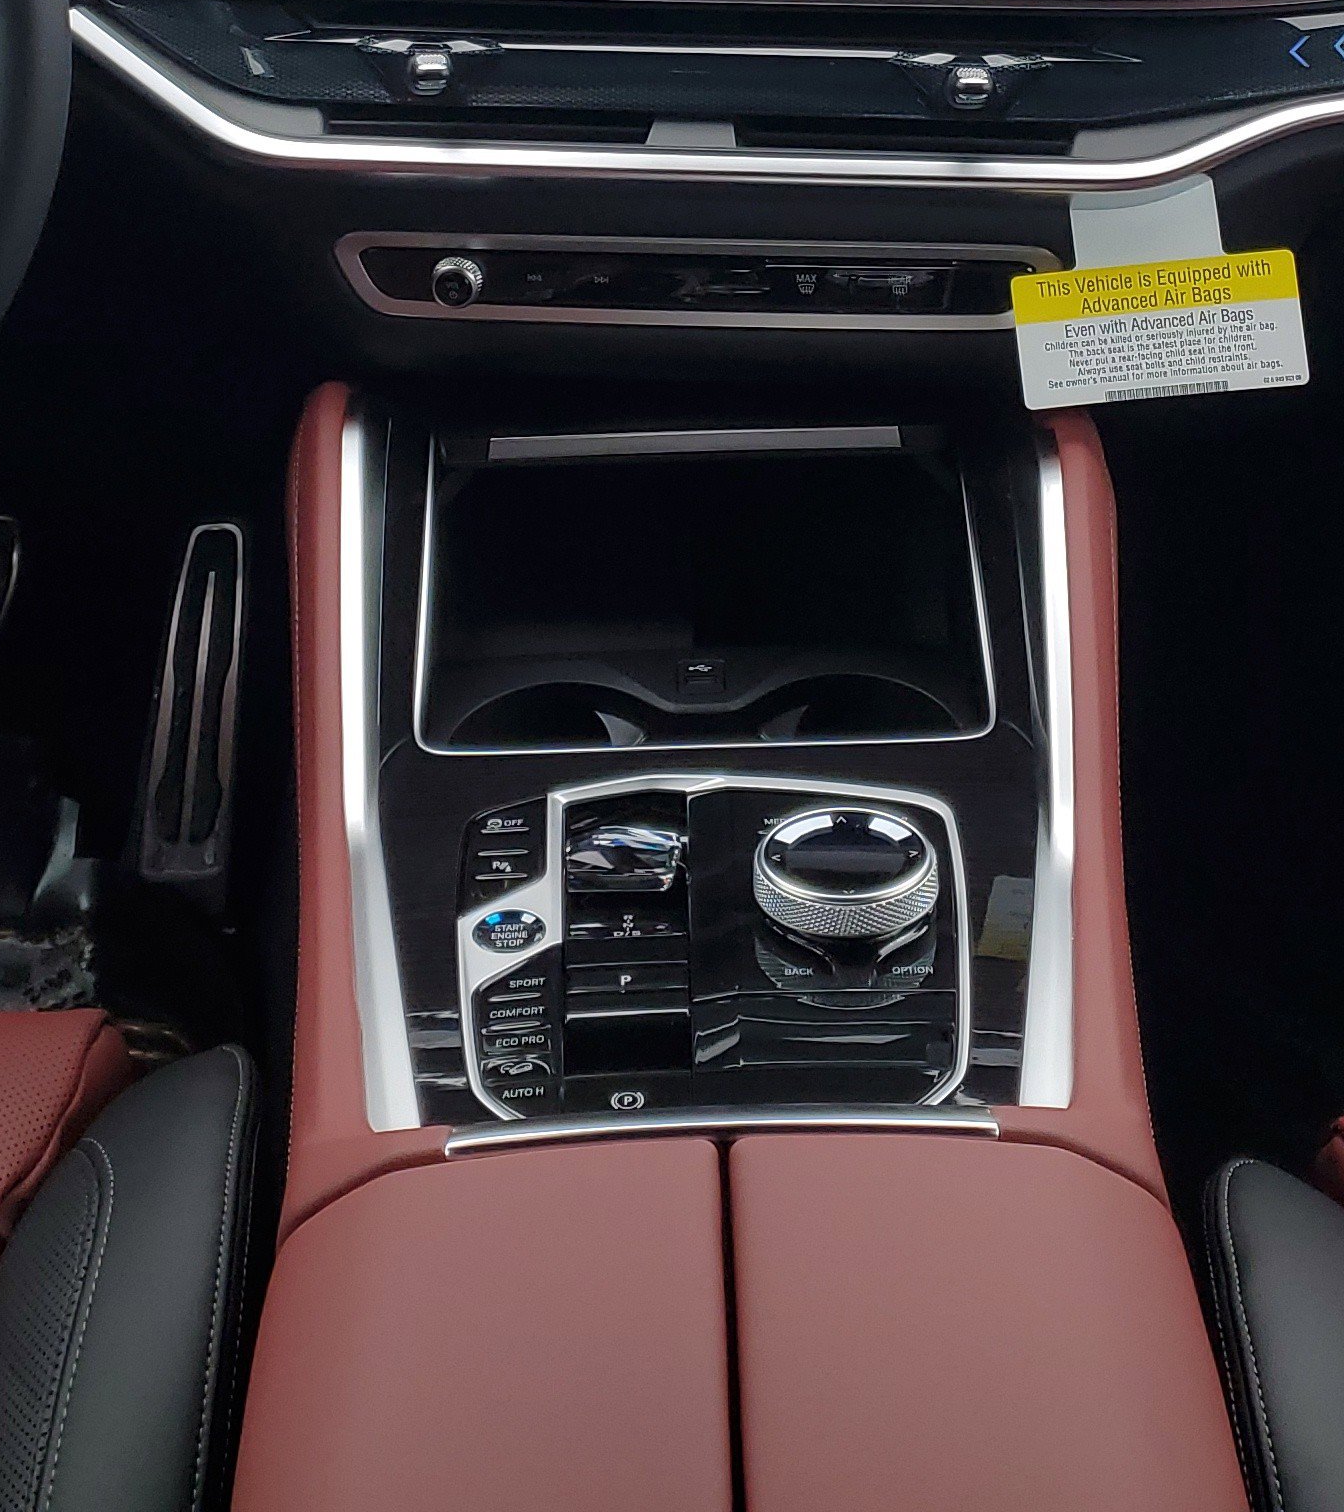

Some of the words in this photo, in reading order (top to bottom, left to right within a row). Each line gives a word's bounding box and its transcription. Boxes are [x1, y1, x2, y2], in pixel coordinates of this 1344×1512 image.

[796, 274, 817, 283] MAX
[1036, 279, 1071, 298] This
[1074, 273, 1133, 294] Vehicle
[1138, 271, 1152, 288] is
[1157, 262, 1231, 287] Equipped
[1236, 259, 1271, 278] with
[1081, 290, 1158, 314] Advanced
[1164, 289, 1187, 306] Air
[1192, 287, 1232, 304] Bags
[1064, 324, 1096, 339] Even
[1099, 319, 1128, 335] with
[1131, 312, 1195, 332] Advanced
[1199, 310, 1217, 325] Air
[1221, 308, 1254, 324] Bags
[1044, 341, 1079, 352] Children
[1081, 339, 1096, 348] can
[1098, 337, 1108, 346] be
[1110, 334, 1133, 345] killed
[1145, 330, 1184, 342] seriously
[1186, 327, 1215, 338] injured
[1218, 326, 1227, 336] by
[1230, 324, 1244, 333] the
[1246, 323, 1257, 331] air
[1259, 322, 1278, 331] bag.
[1069, 349, 1084, 358] The
[1086, 347, 1105, 357] back
[1108, 345, 1125, 355] seat
[1137, 343, 1150, 352] the
[1152, 339, 1177, 350] safest
[1180, 337, 1201, 349] place
[1204, 336, 1216, 345] for
[1218, 333, 1255, 344] children.
[1069, 358, 1093, 368] Never
[1095, 356, 1108, 366] put
[1165, 347, 1186, 358] child
[1188, 346, 1205, 356] seat
[1218, 344, 1232, 353] the
[1078, 367, 1106, 377] Always
[1109, 365, 1124, 374] use
[1126, 362, 1143, 372] seat
[1167, 358, 1183, 368] and
[1185, 355, 1206, 366] child
[1048, 380, 1064, 389] See
[1066, 376, 1098, 387] owner's
[1100, 373, 1130, 384] manual
[1132, 371, 1144, 380] for
[1147, 370, 1168, 379] more
[1170, 364, 1219, 377] information
[1221, 362, 1245, 372] about
[1247, 361, 1258, 370] air
[1260, 360, 1284, 370] bags.
[504, 819, 523, 827] OFF
[494, 924, 525, 932] START
[495, 939, 523, 948] STOP
[784, 967, 814, 976] BACK
[892, 966, 934, 975] OPTION
[509, 977, 546, 988] SPORT
[620, 974, 632, 986] P
[489, 1006, 545, 1019] COMFORT
[496, 1037, 519, 1048] ECO
[521, 1035, 545, 1046] PRO
[502, 1088, 532, 1100] AUTO
[534, 1087, 544, 1098] H
